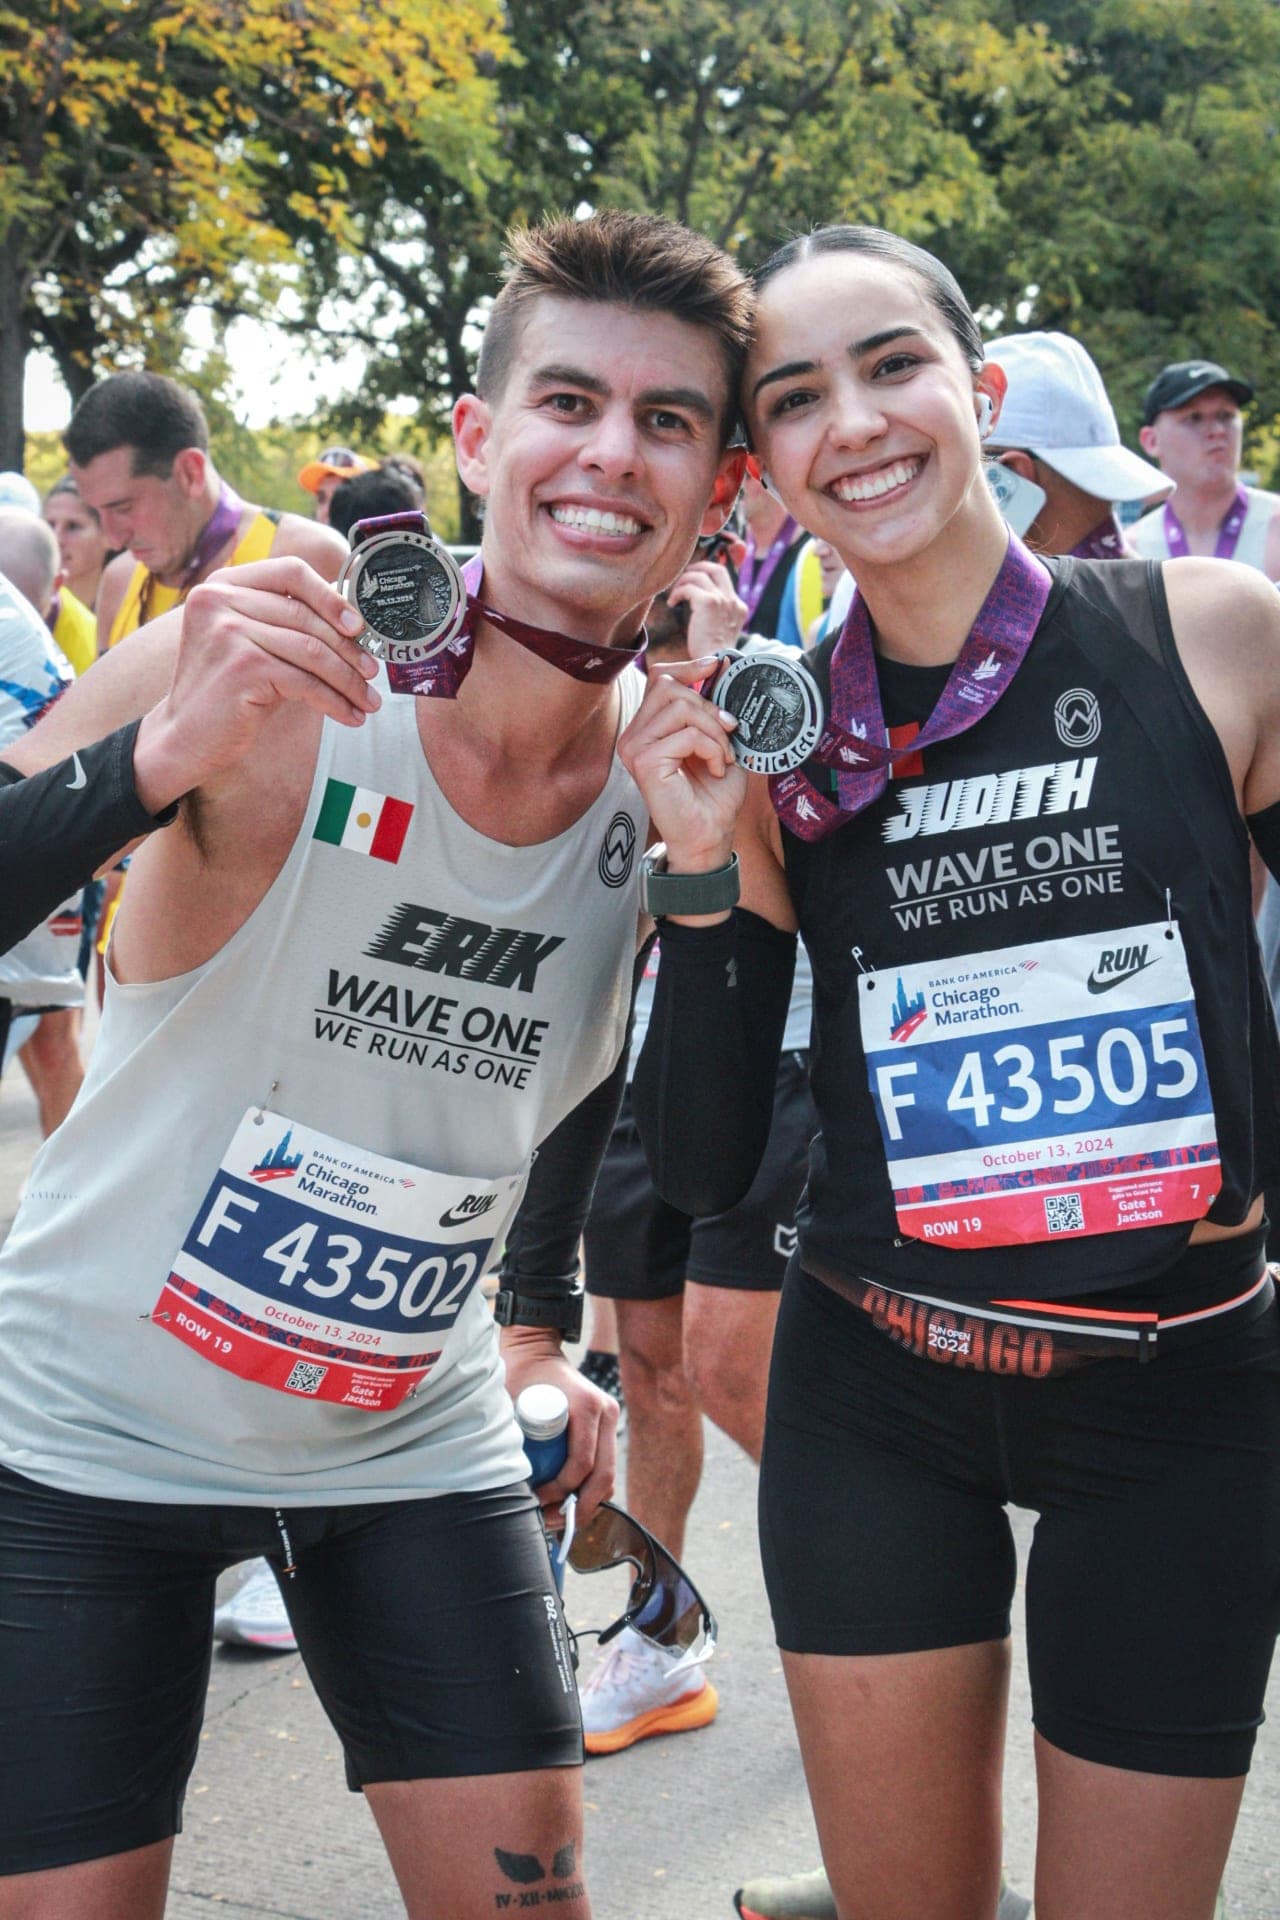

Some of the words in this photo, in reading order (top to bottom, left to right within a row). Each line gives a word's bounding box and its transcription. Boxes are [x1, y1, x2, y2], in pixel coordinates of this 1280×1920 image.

[743, 725, 818, 772] CHICAGO
[880, 756, 1099, 843] JUDITH
[885, 842, 1017, 899] WAVE
[1024, 824, 1123, 871] ONE
[894, 903, 942, 932] WE
[950, 887, 1009, 920] RUN
[1018, 881, 1053, 907] AS
[1060, 871, 1124, 898] ONE
[361, 902, 567, 993] ERIK
[1097, 943, 1150, 975] RUN
[928, 977, 956, 988] BANK
[957, 974, 970, 983] OF
[972, 966, 1018, 980] AMERICA
[327, 968, 459, 1036] WAVE
[461, 1006, 550, 1057] ONE
[932, 986, 1001, 1008] Chicago
[314, 1017, 363, 1049] WE
[367, 1032, 429, 1066] RUN
[431, 1050, 470, 1075] AS
[474, 1059, 532, 1090] ONE
[875, 1061, 918, 1141] F
[946, 1018, 1199, 1128] 43505
[313, 1150, 339, 1166] BANK
[340, 1161, 353, 1170] OF
[353, 1167, 395, 1184] AMERICA
[982, 1147, 1042, 1168] October
[1047, 1141, 1071, 1158] 13,
[1075, 1136, 1115, 1154] 2024
[305, 1162, 370, 1195] Chicago
[1190, 1184, 1200, 1199] 7
[455, 1193, 498, 1213] RUN
[1117, 1209, 1163, 1226] Jackson
[1119, 1199, 1146, 1211] Gate
[1149, 1196, 1156, 1206] 1
[923, 1220, 959, 1238] ROW
[962, 1217, 983, 1232] 19
[196, 1185, 260, 1248] F
[262, 1221, 478, 1318] 43502
[175, 1312, 212, 1342] ROW
[212, 1335, 234, 1354] 19
[264, 1305, 319, 1333] October
[323, 1324, 344, 1341] 13,
[347, 1331, 382, 1347] 2024
[860, 1286, 1053, 1379] CHICAGO
[929, 1323, 946, 1335] RUN
[946, 1329, 971, 1342] OPEN
[928, 1333, 970, 1355] 2024
[341, 1392, 382, 1407] Jackson
[351, 1385, 375, 1397] Gate
